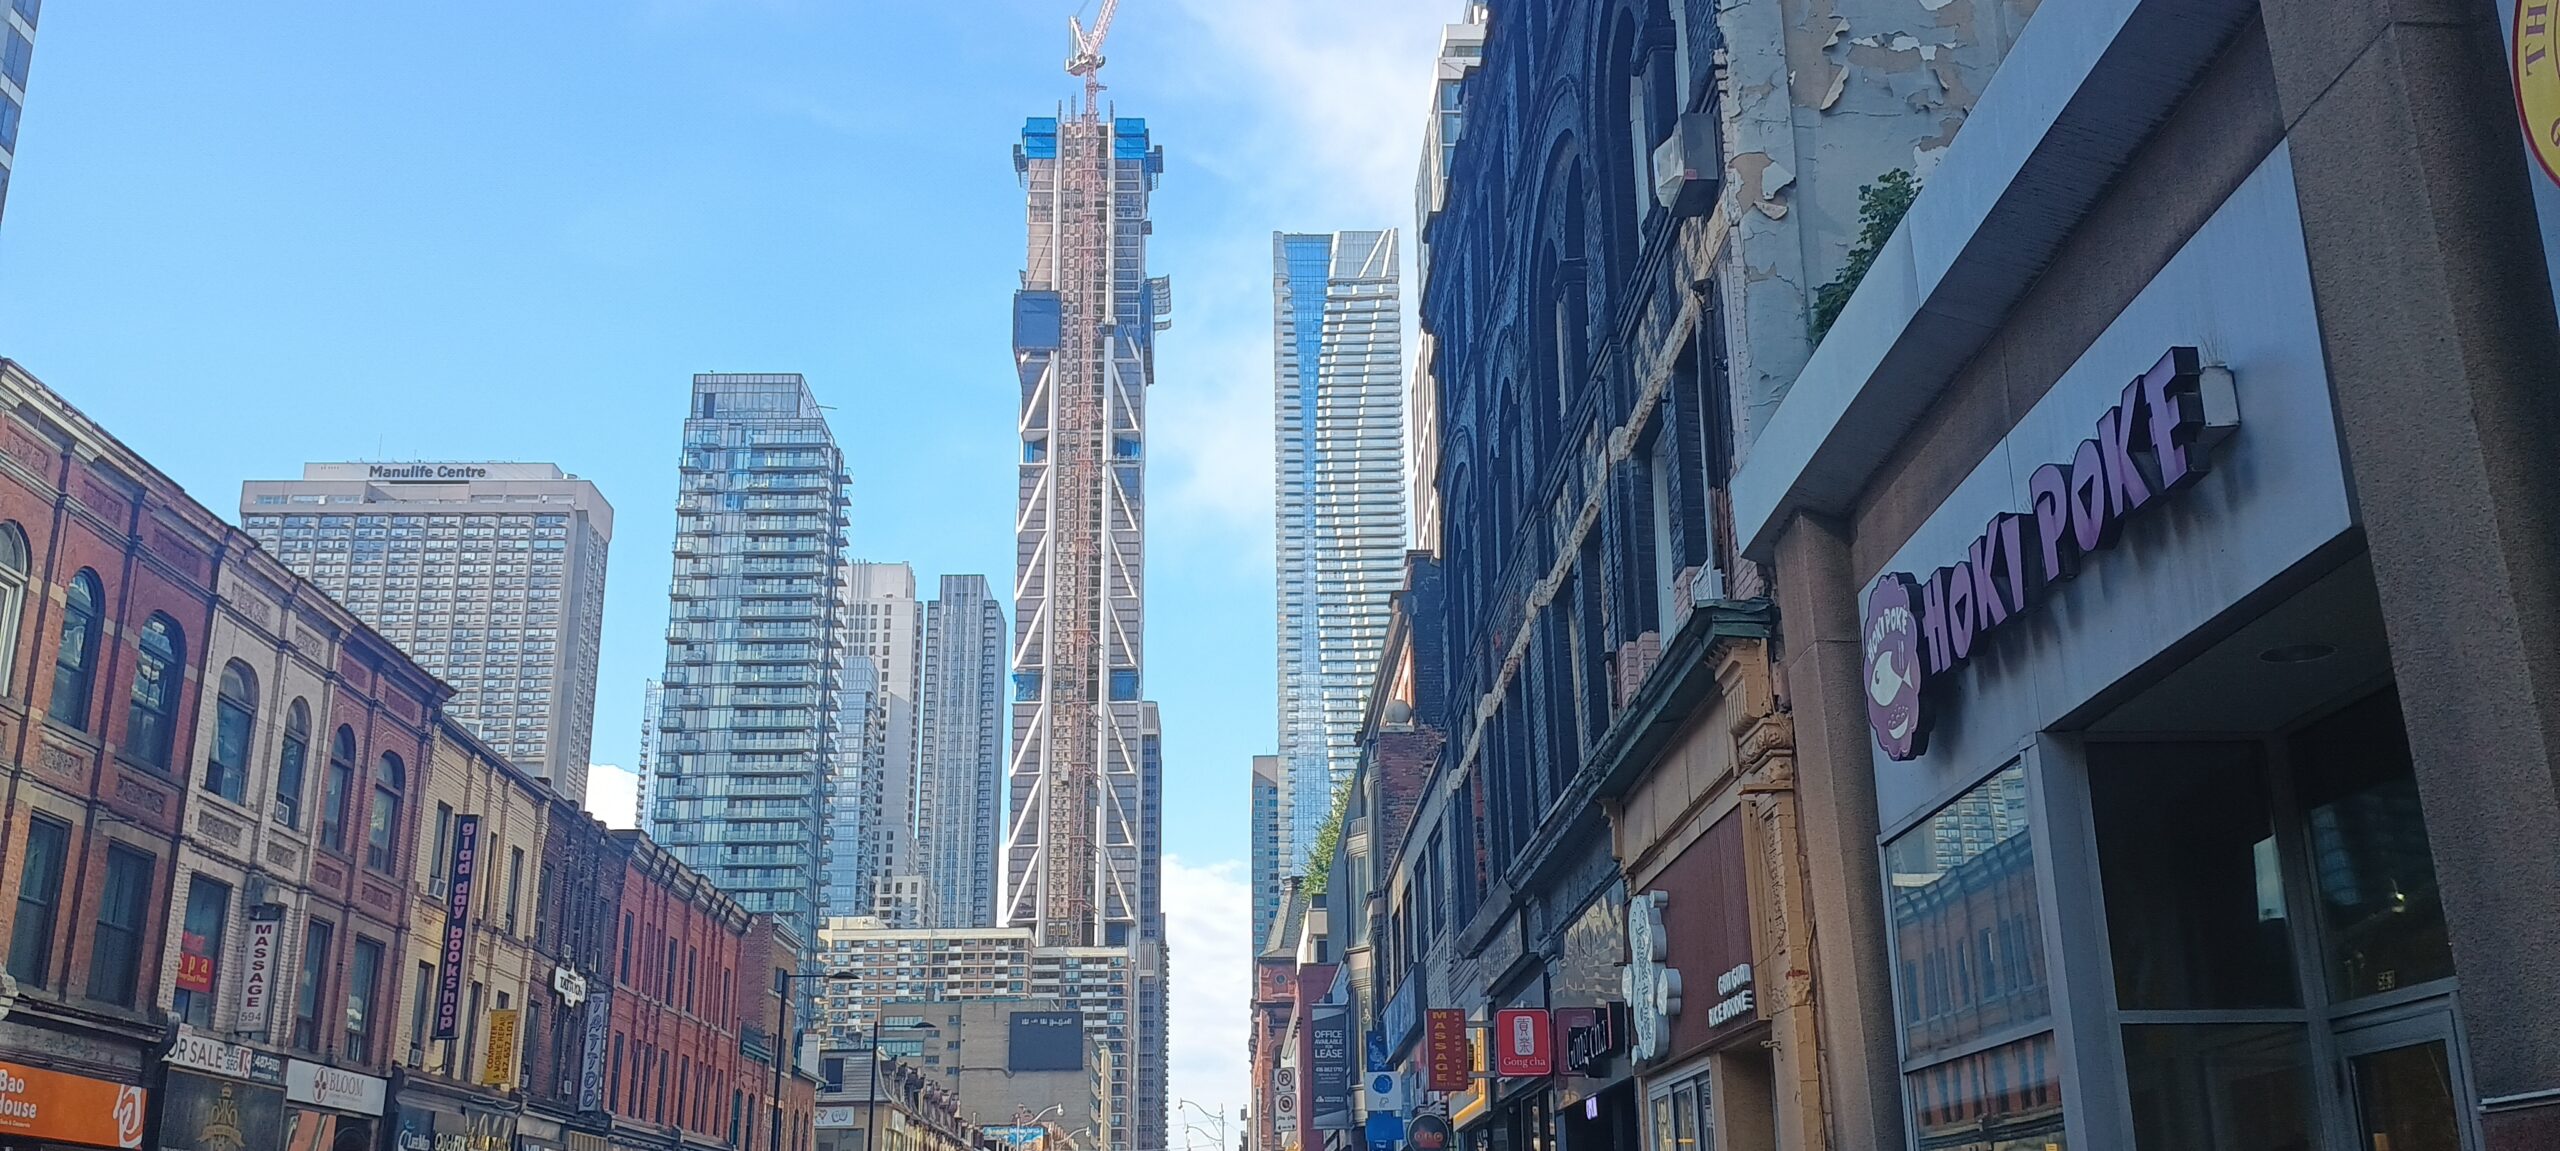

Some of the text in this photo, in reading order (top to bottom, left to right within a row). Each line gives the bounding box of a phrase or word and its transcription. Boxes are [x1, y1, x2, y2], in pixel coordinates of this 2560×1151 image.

[369, 465, 486, 478] Manulife Centre
[1922, 347, 2190, 676] HOKI POKE
[1867, 615, 1885, 664] HOKI
[439, 822, 475, 1031] glad day bookshop
[246, 924, 273, 1008] MASSAGE
[240, 1011, 262, 1021] 594
[1314, 1030, 1343, 1039] OFFICE
[189, 1040, 223, 1069] SALE
[486, 1024, 499, 1070] COMPUTER
[582, 995, 604, 1108] TATTOO
[1314, 1049, 1343, 1058] LEASE
[1432, 1011, 1448, 1081] MASSAGE
[1503, 1056, 1546, 1069] Gong cha
[0, 1069, 25, 1093] Bao
